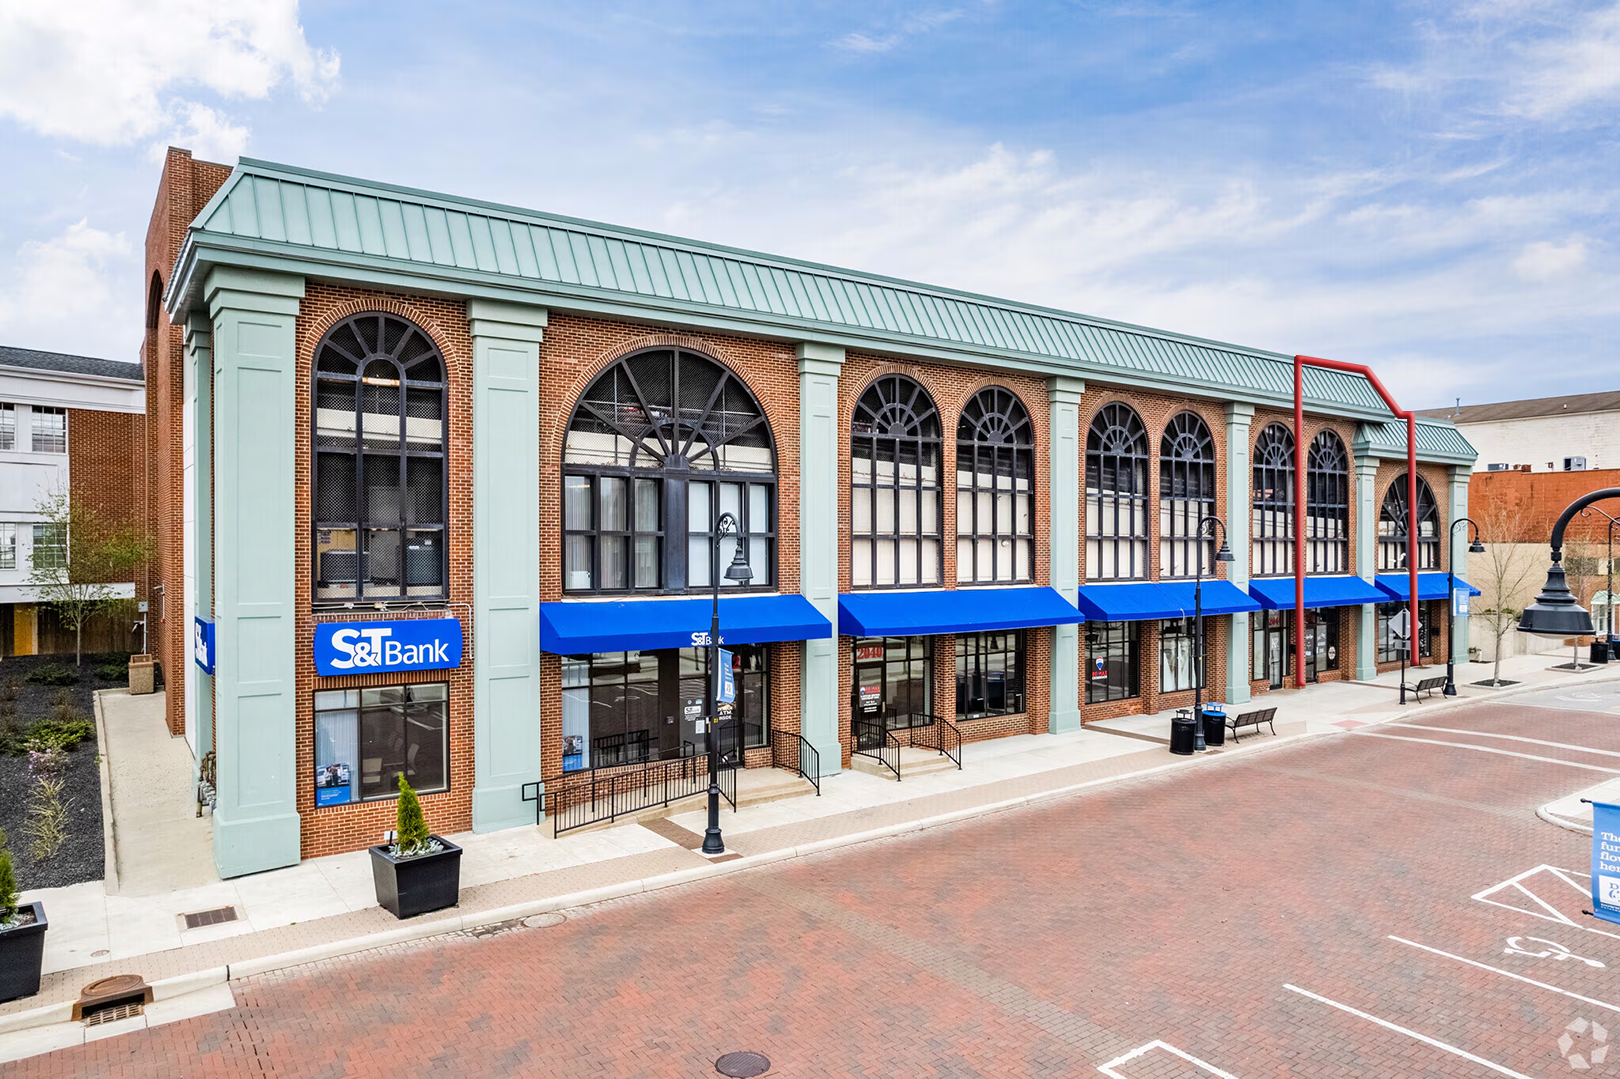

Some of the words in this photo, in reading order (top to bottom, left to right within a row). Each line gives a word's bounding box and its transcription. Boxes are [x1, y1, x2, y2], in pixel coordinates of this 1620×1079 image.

[691, 632, 708, 646] S&T
[330, 628, 392, 669] S&T
[385, 638, 450, 666] Bank
[857, 647, 883, 660] 2040
[1600, 832, 1620, 843] Th
